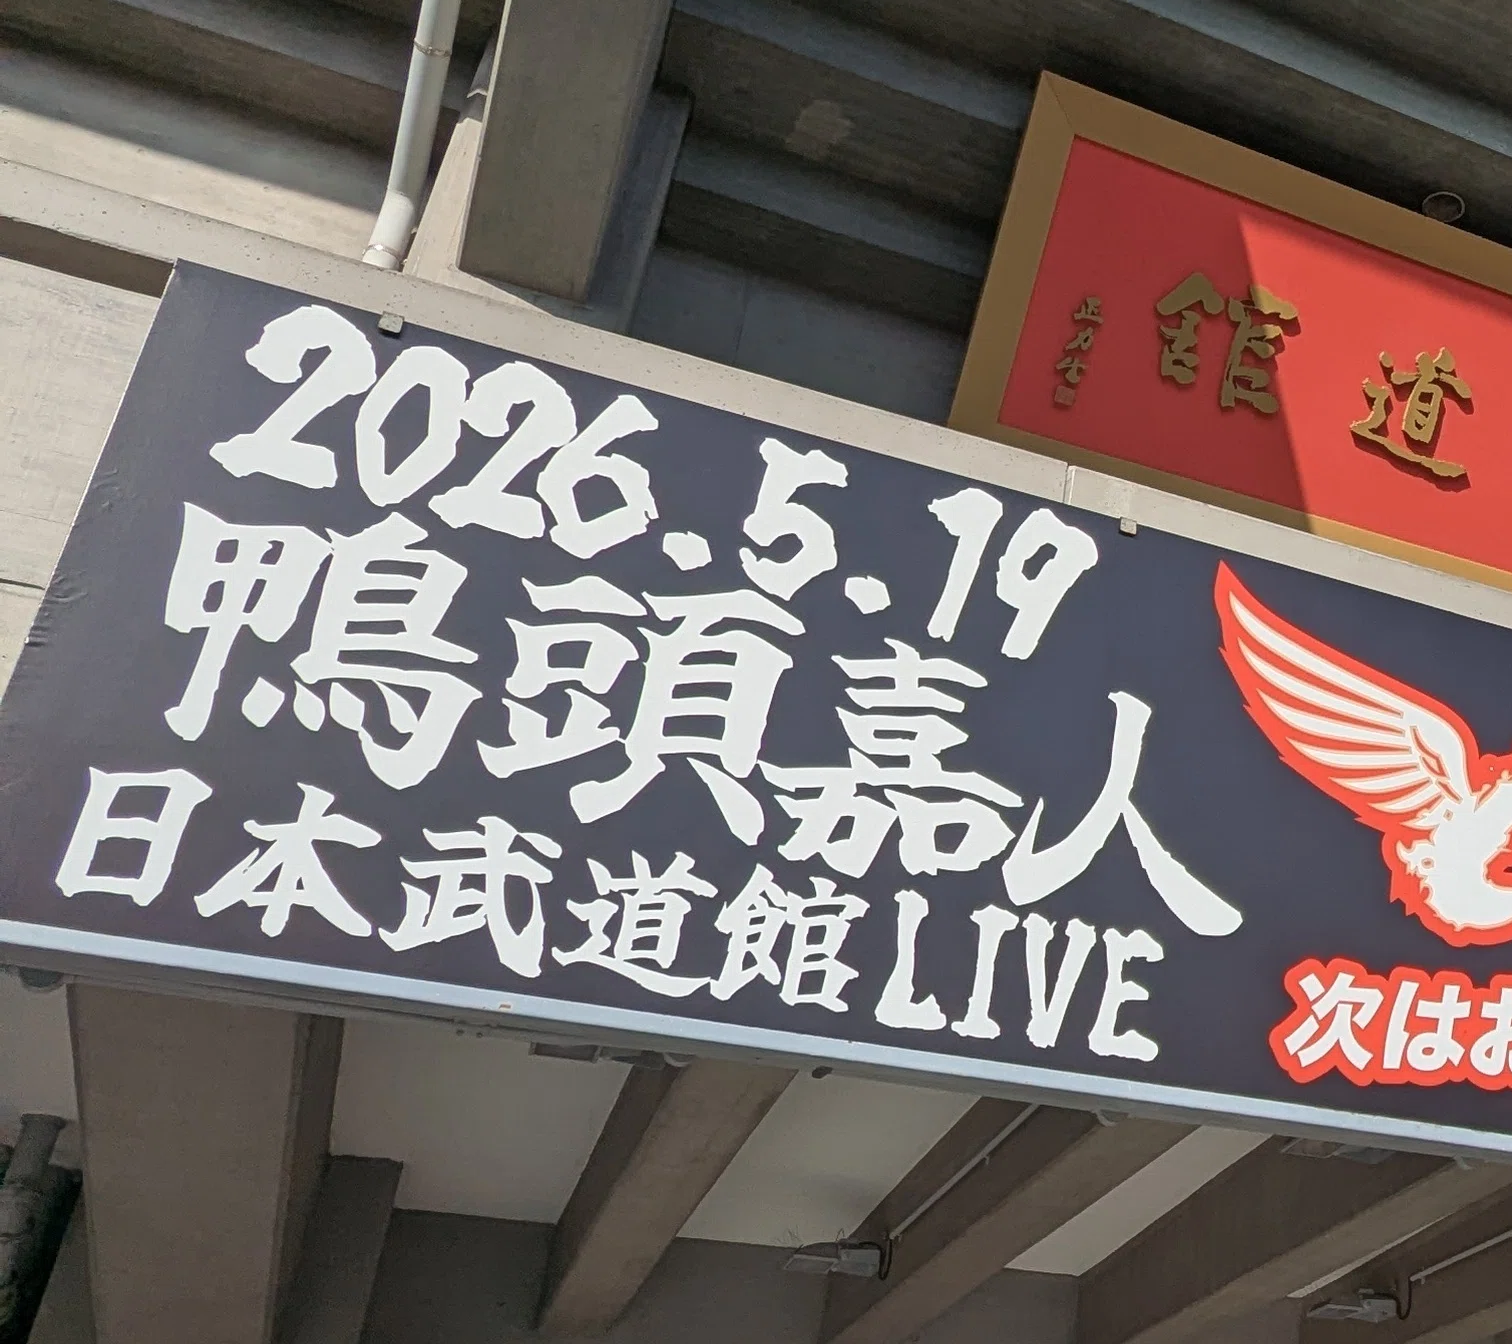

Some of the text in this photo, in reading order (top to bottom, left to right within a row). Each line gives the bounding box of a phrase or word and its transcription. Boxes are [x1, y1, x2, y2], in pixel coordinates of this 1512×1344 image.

[210, 304, 1099, 660] 2026.5.19
[164, 501, 1243, 936] 鴨頭嘉人
